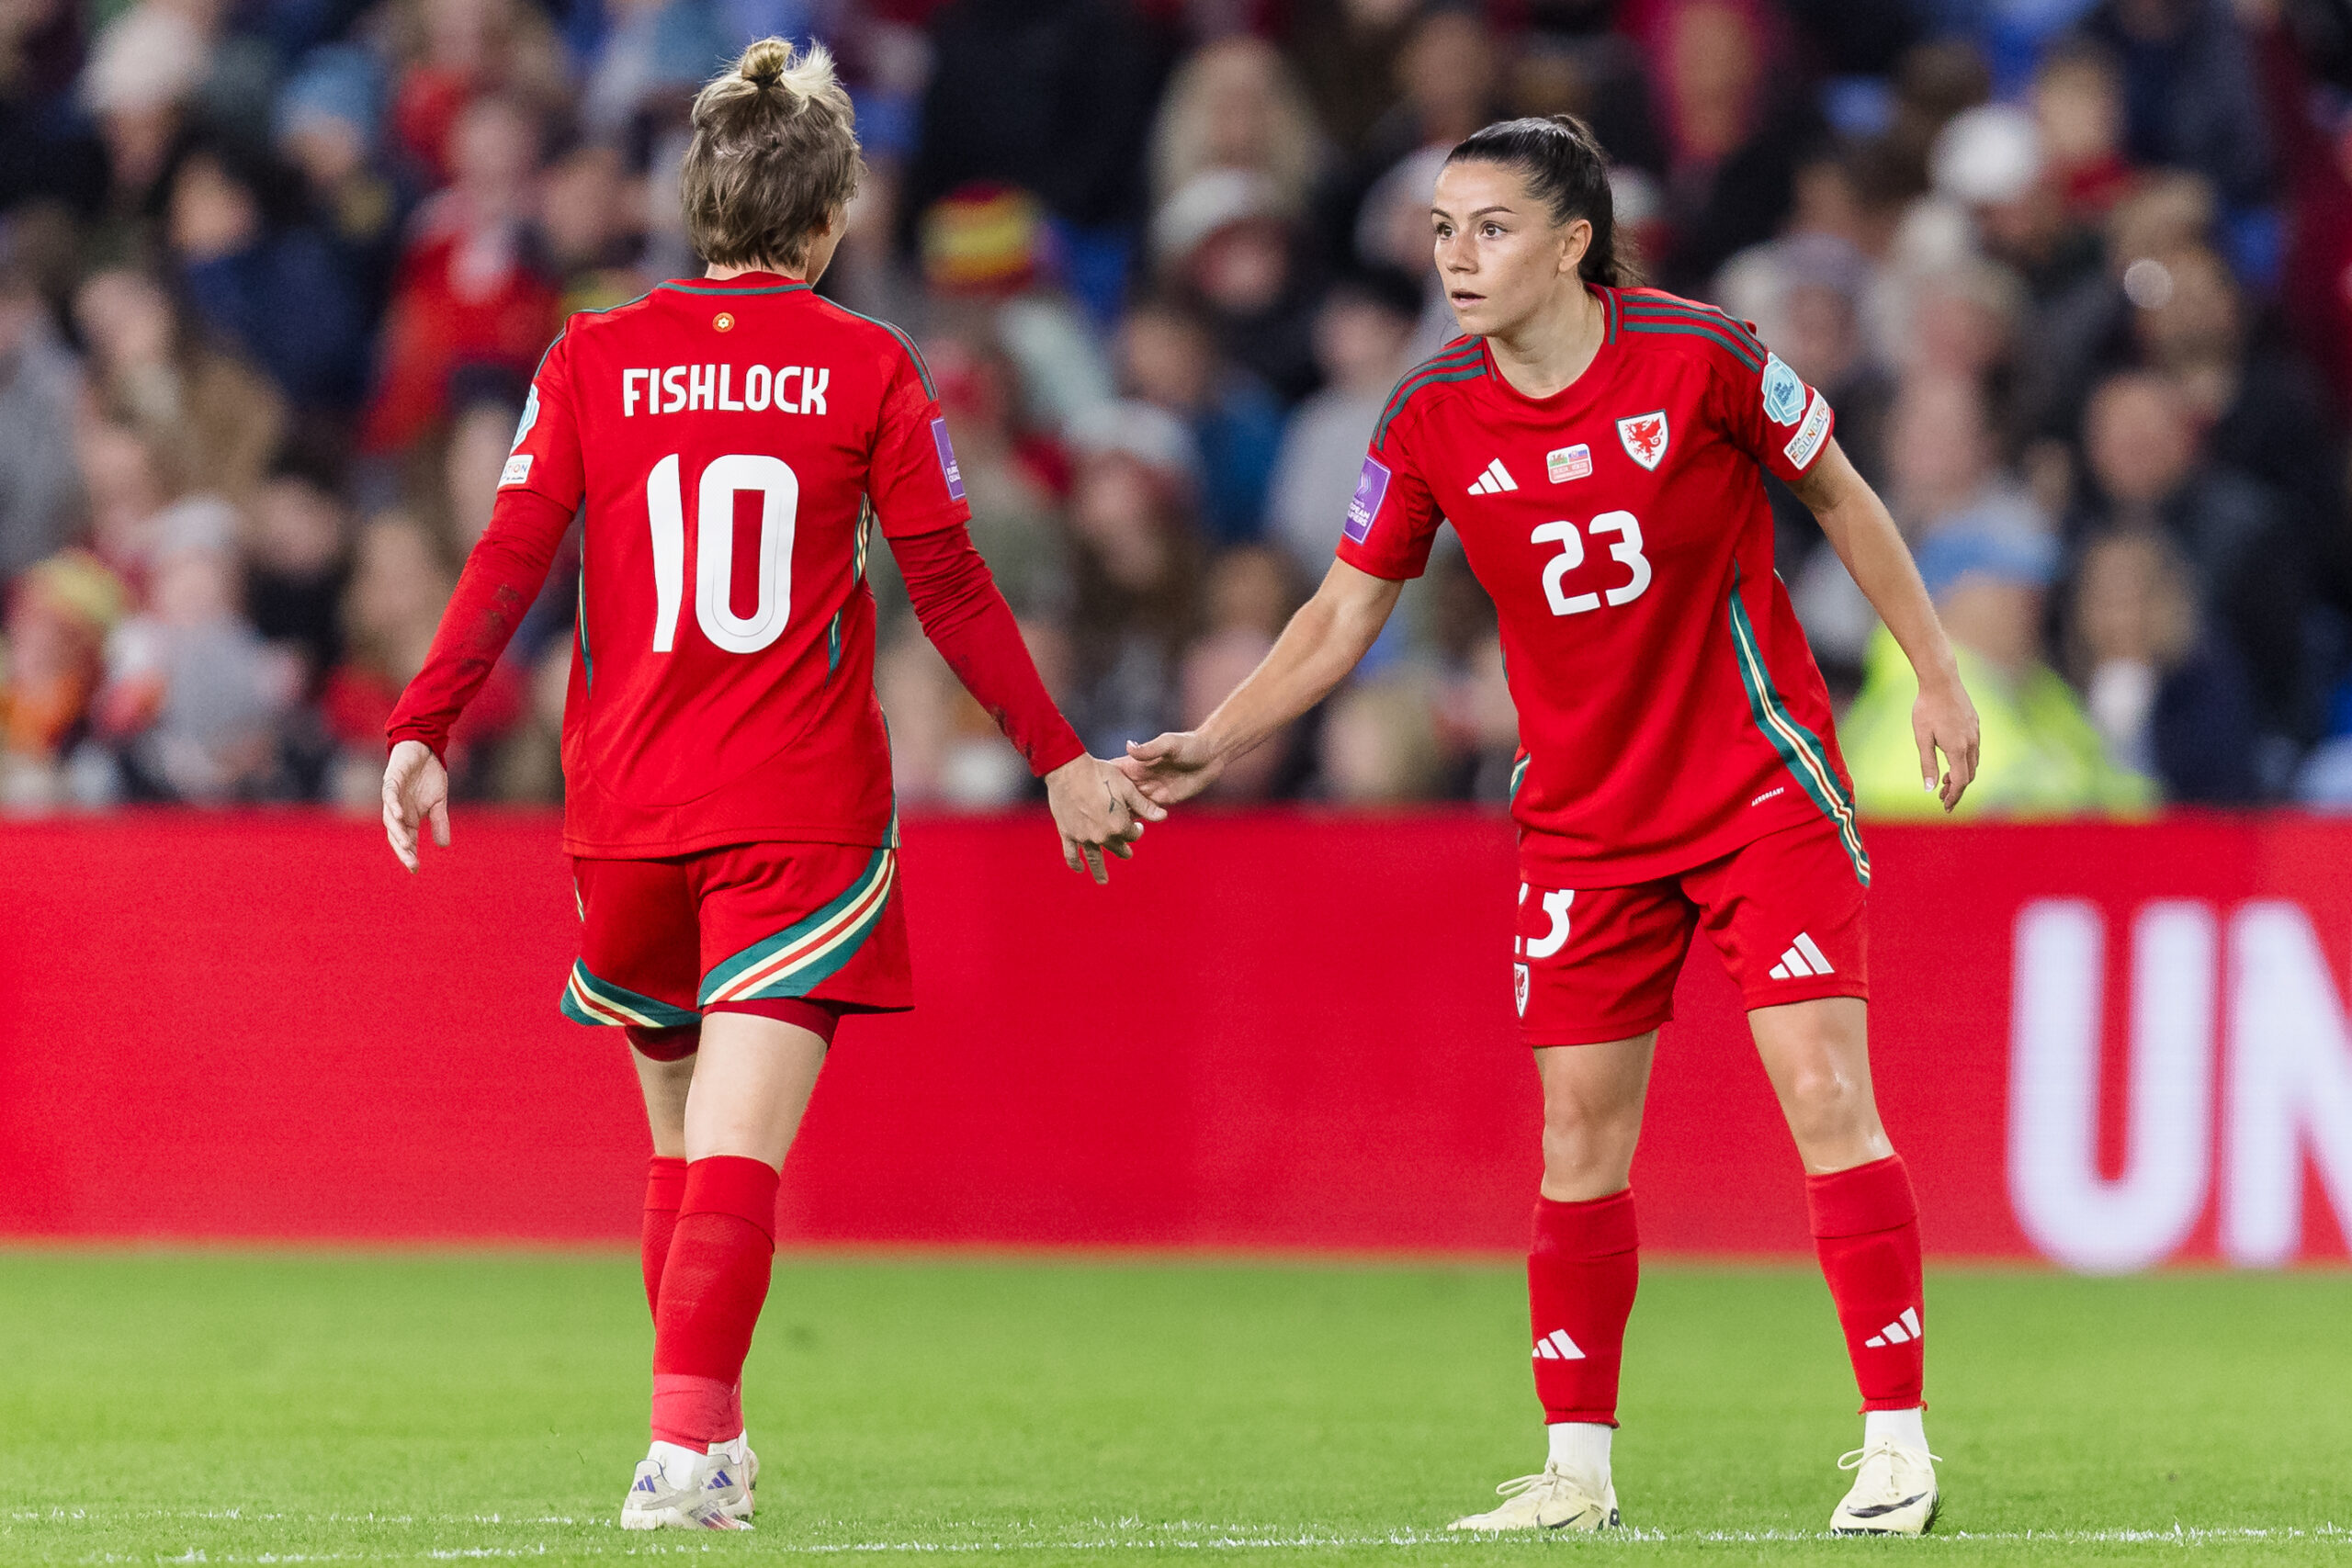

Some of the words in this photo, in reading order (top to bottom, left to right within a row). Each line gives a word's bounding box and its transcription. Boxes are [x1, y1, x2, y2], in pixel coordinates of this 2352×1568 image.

[623, 364, 830, 416] FISHLOCK
[647, 453, 798, 654] 10
[1531, 510, 1652, 616] 23
